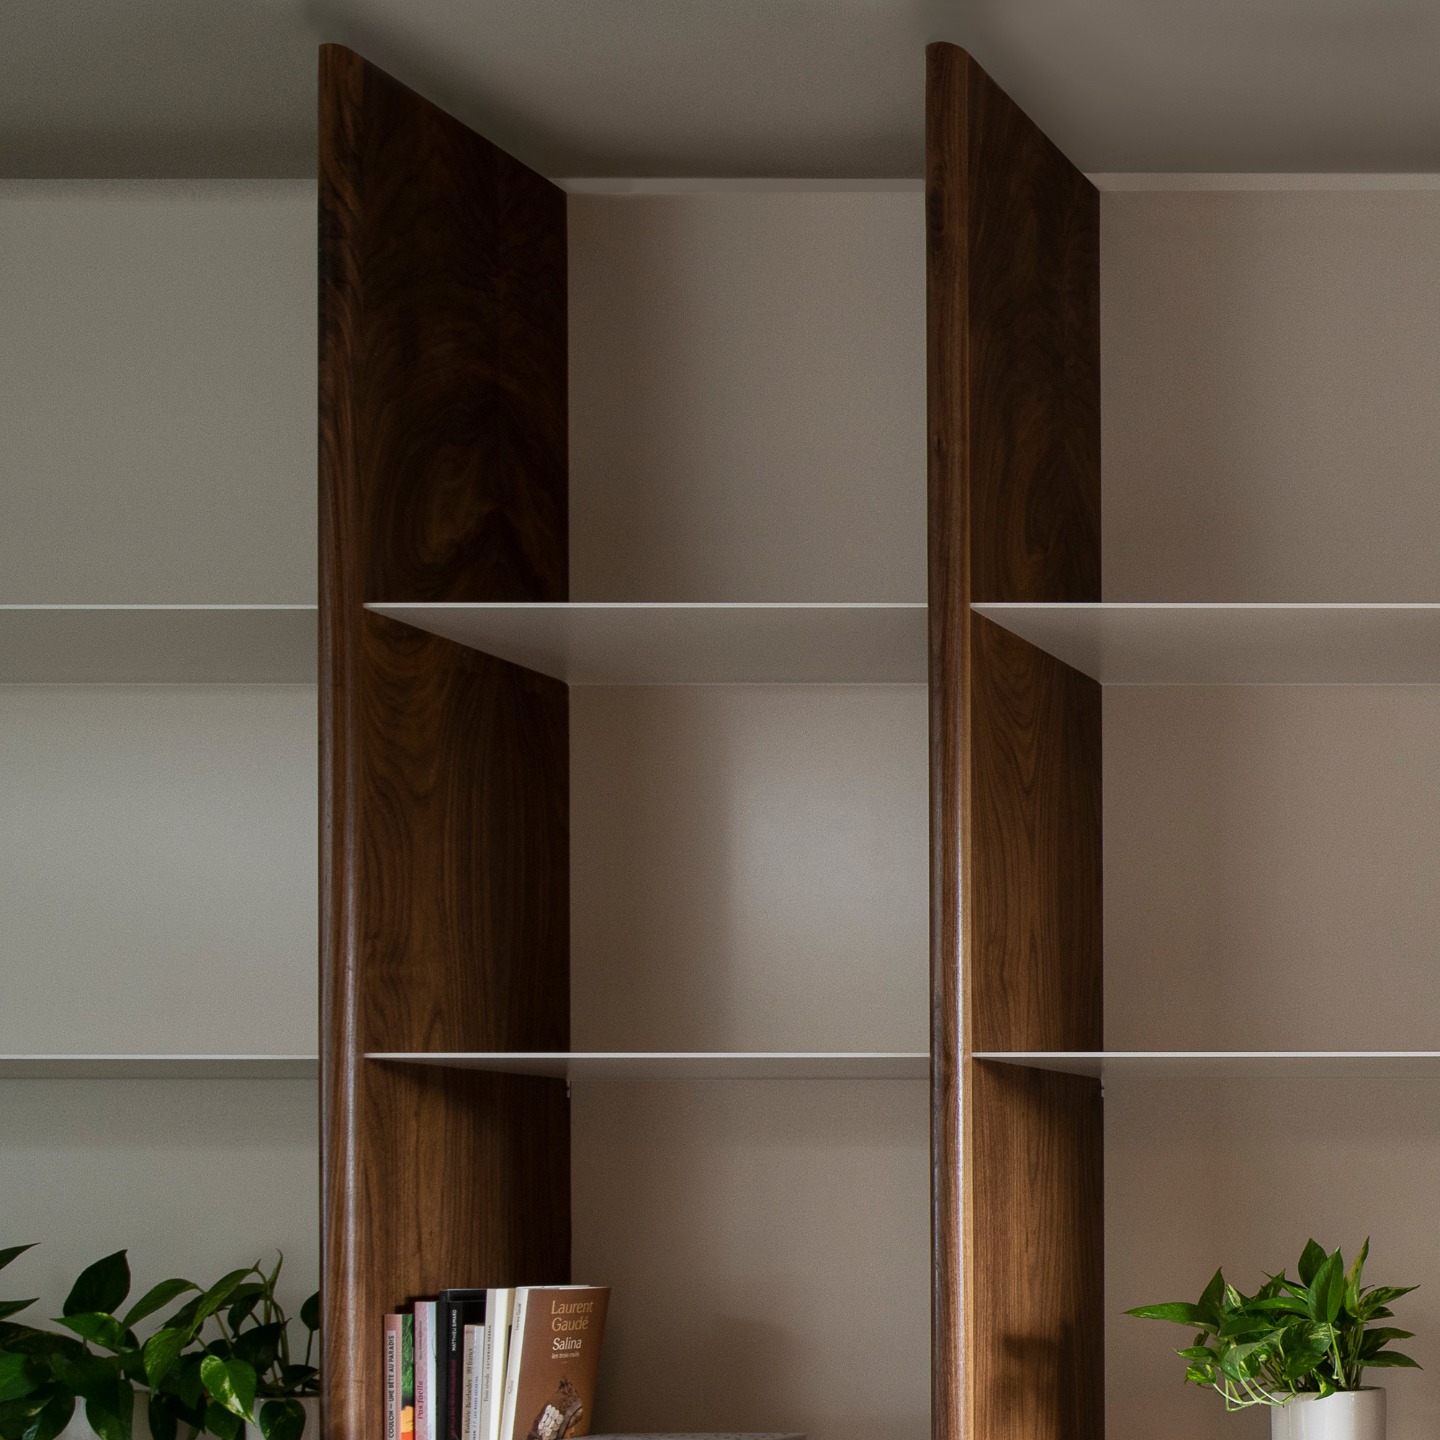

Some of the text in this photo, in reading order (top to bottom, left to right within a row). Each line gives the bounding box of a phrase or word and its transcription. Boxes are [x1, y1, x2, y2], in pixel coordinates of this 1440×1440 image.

[552, 1301, 593, 1314] Laurent
[552, 1317, 588, 1331] Gaudé
[553, 1338, 581, 1351] Salina
[388, 1364, 394, 1372] AU
